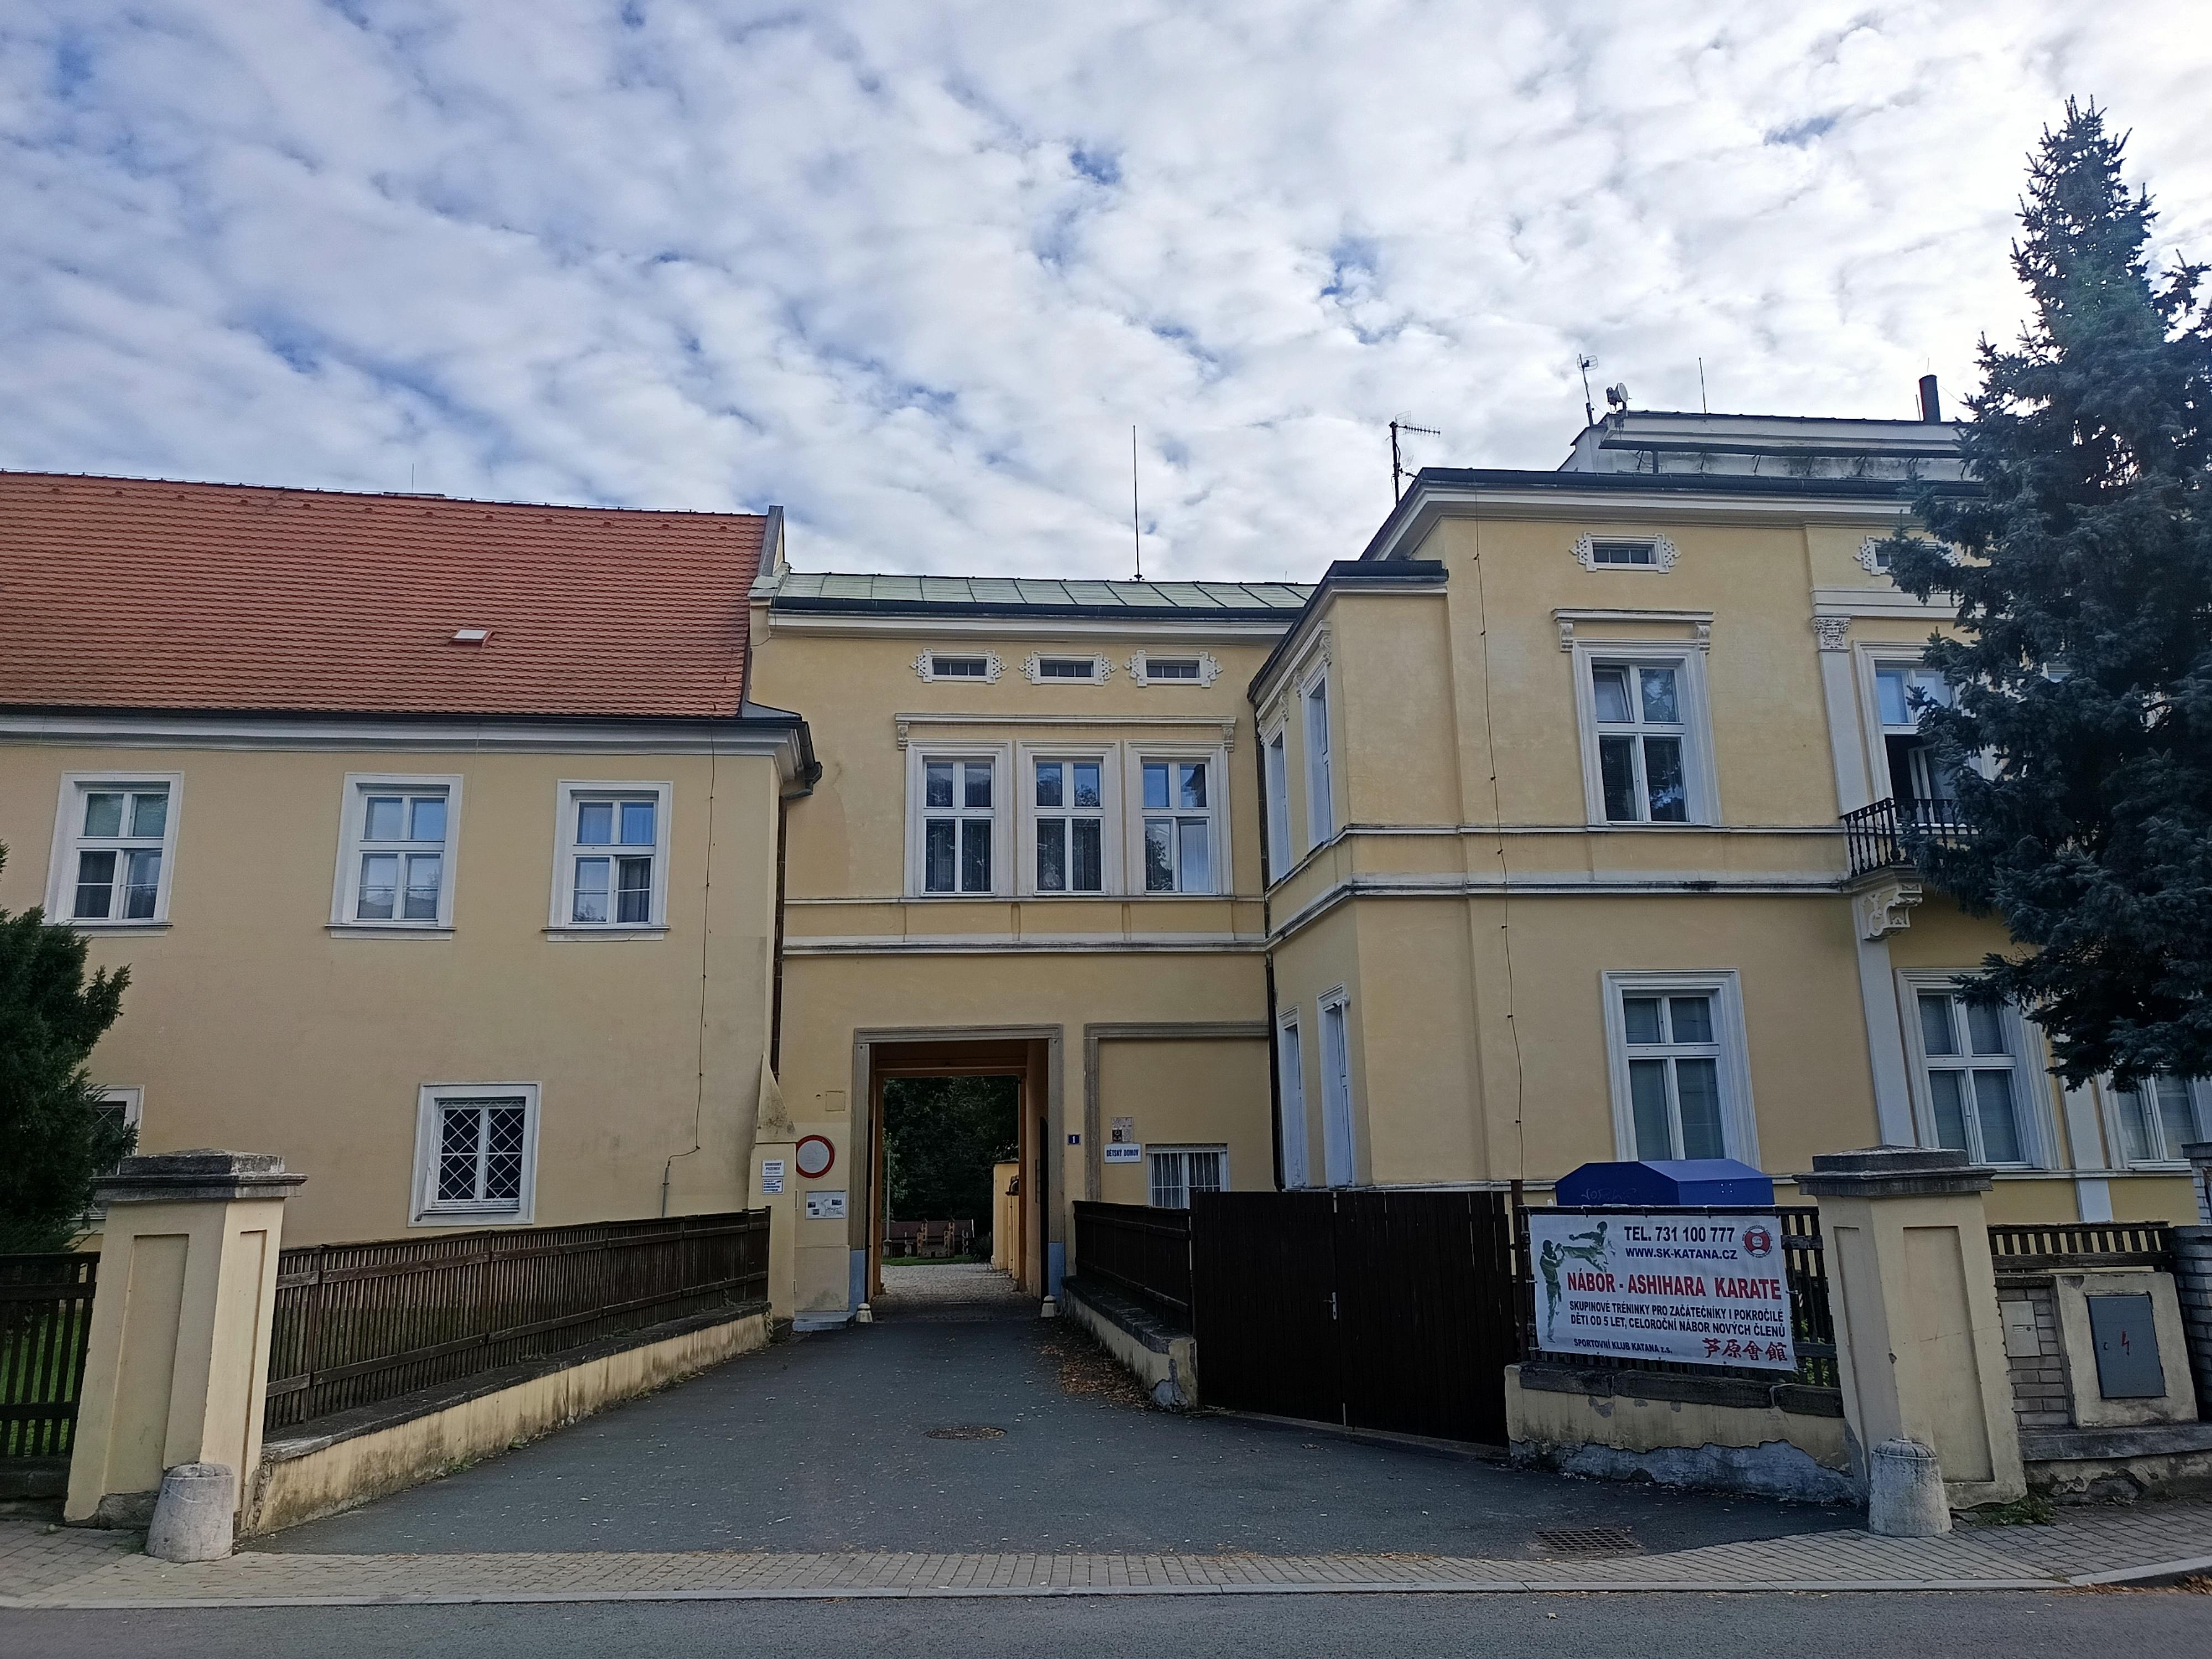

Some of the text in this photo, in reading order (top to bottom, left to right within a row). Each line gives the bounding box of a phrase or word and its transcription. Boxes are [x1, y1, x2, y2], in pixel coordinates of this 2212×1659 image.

[1624, 1226, 1651, 1241] TEL.
[1655, 1226, 1677, 1241] 731
[1683, 1227, 1706, 1242] 100
[1710, 1227, 1735, 1243] 777
[1625, 1248, 1738, 1260] WWW.SK-KATANA.CZ
[1567, 1268, 1616, 1292] NÁBOR
[1627, 1274, 1706, 1297] ASHIHARA
[1715, 1277, 1781, 1300] KARATE
[1569, 1300, 1783, 1322] SKUPINOVÉ TRÉNINKY PRO ZAČÁTEČNÍKY I POKROČILÉ
[1571, 1312, 1785, 1337] DĚTI OD 5 LET, CELOROČNÍ NÁBOR NOVÝCH ČLENŮ
[1574, 1338, 1610, 1349] SPORTOVNÍ
[1611, 1341, 1630, 1350] KLUB
[1631, 1342, 1659, 1353] KATANA
